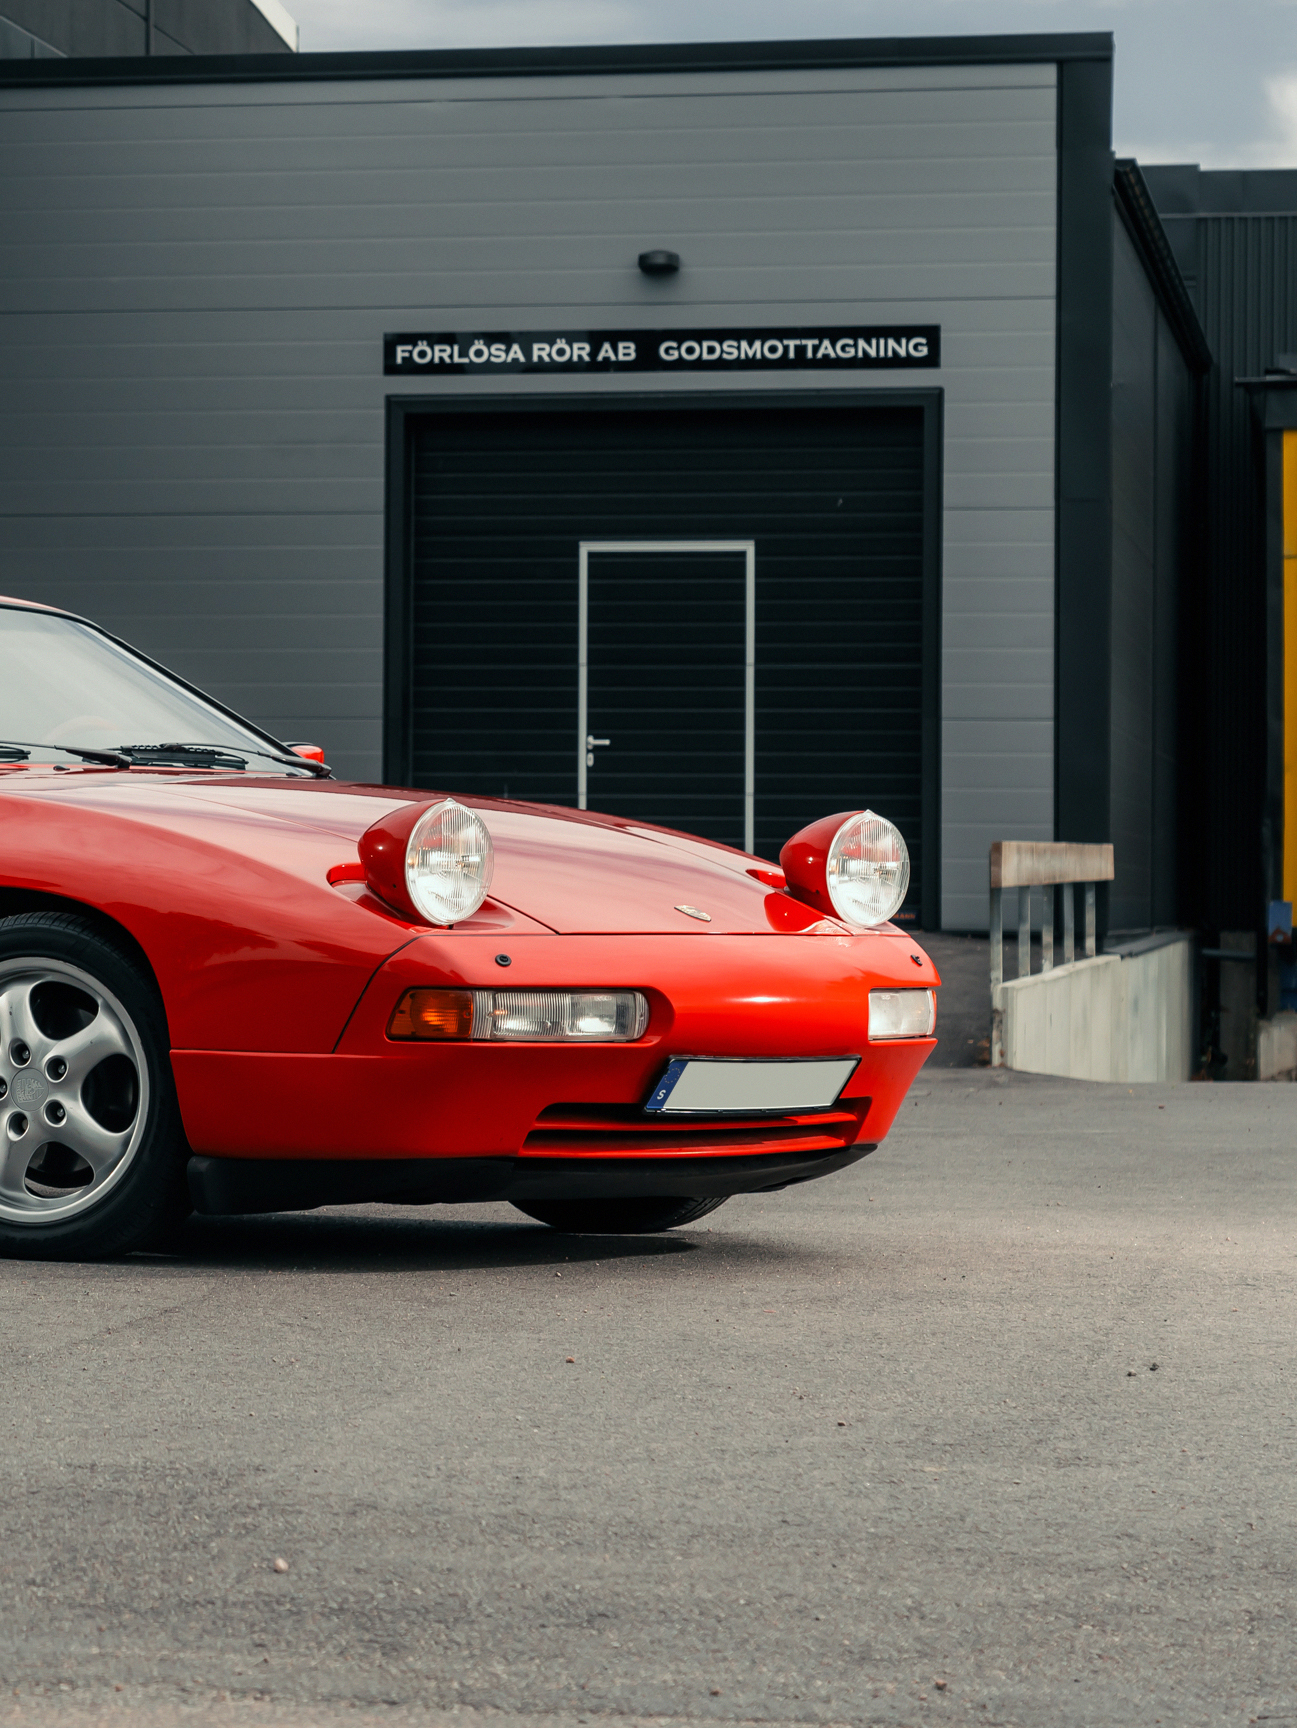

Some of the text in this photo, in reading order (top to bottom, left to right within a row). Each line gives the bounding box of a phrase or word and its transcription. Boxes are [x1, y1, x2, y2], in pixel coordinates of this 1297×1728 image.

[396, 337, 929, 365] FÖRLÖSA RÖR AB GODSMOTTAGNING
[656, 1089, 667, 1100] S
